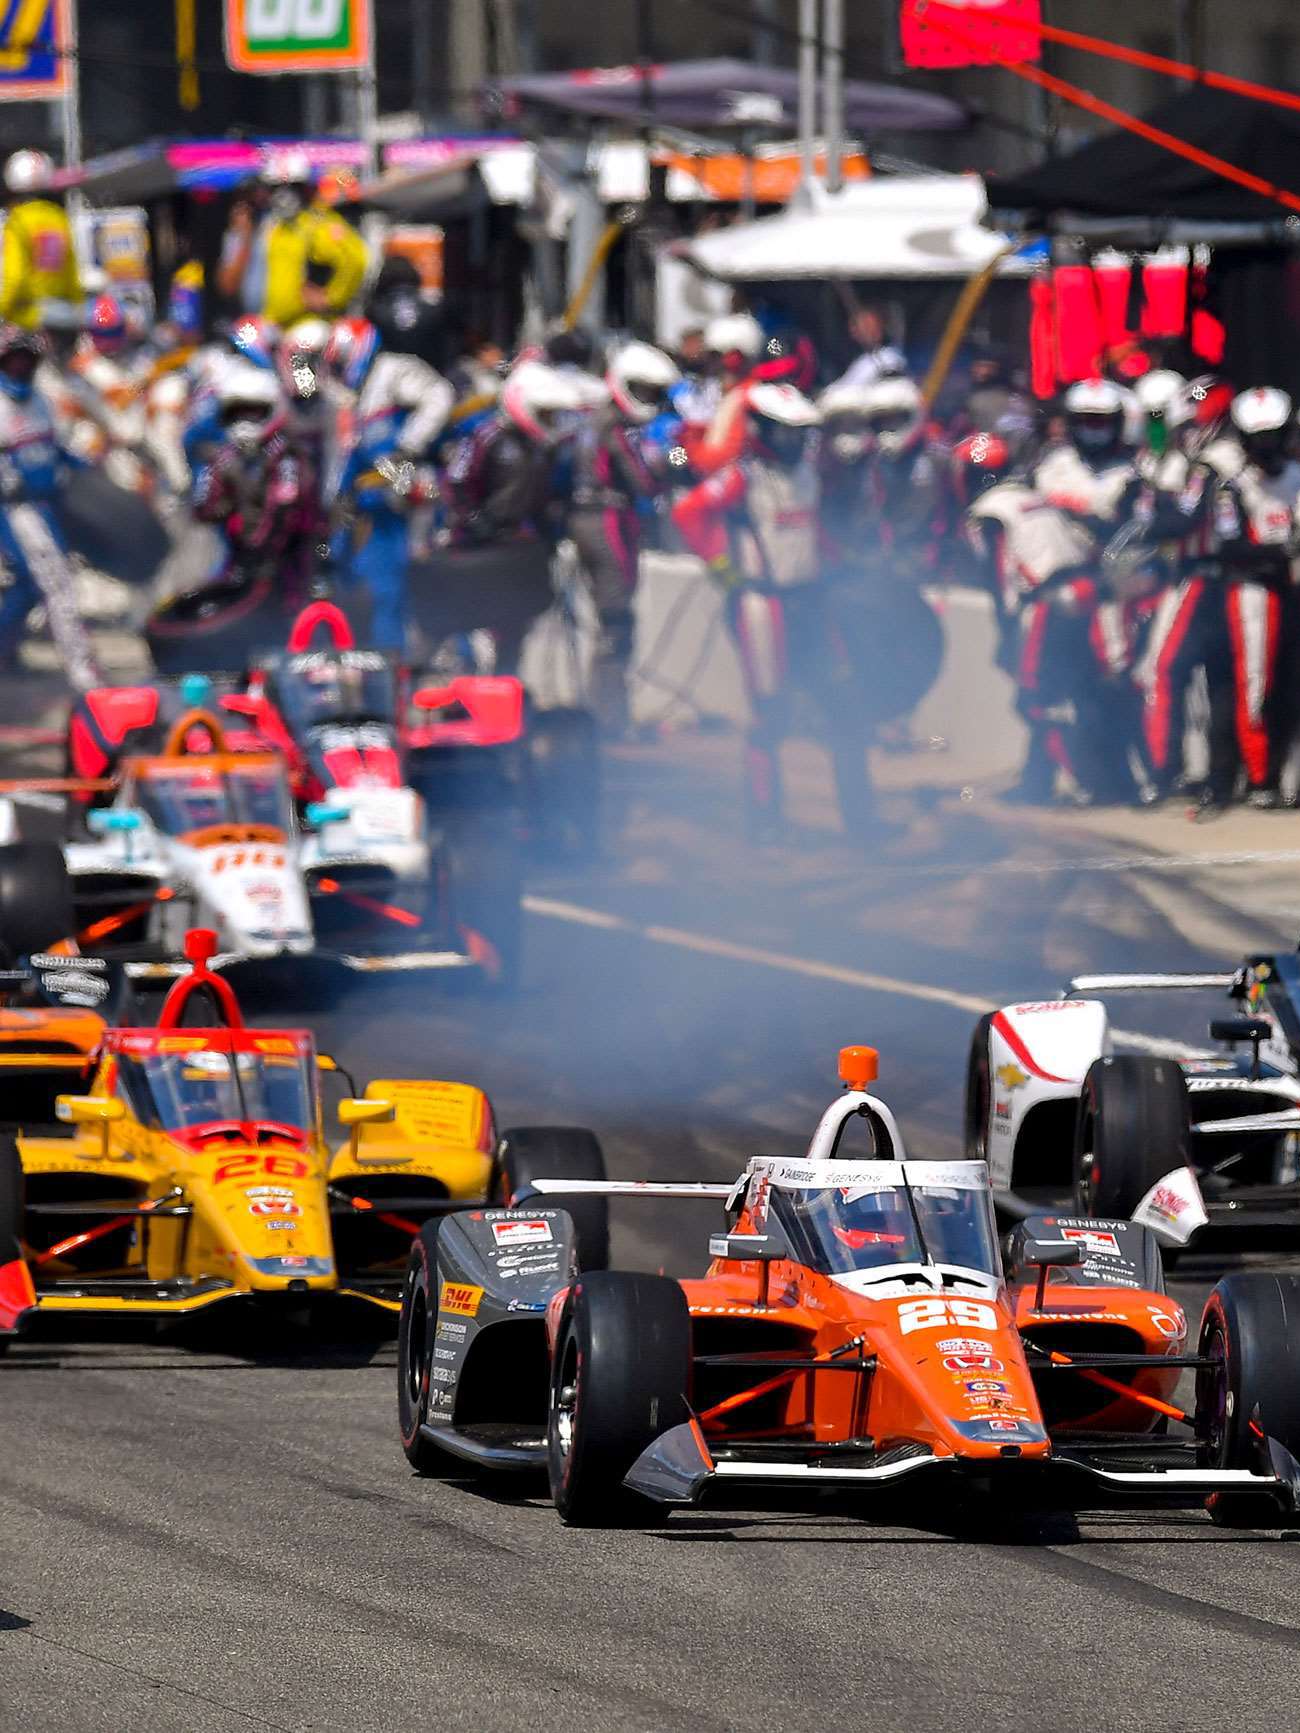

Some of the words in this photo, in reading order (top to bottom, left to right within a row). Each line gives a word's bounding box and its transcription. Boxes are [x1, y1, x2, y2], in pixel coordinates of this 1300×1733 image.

[213, 1155, 308, 1184] 28
[484, 1210, 556, 1220] GENESYS
[1056, 1219, 1128, 1231] GENESYS
[445, 1287, 473, 1310] DHL
[897, 1299, 998, 1336] 29
